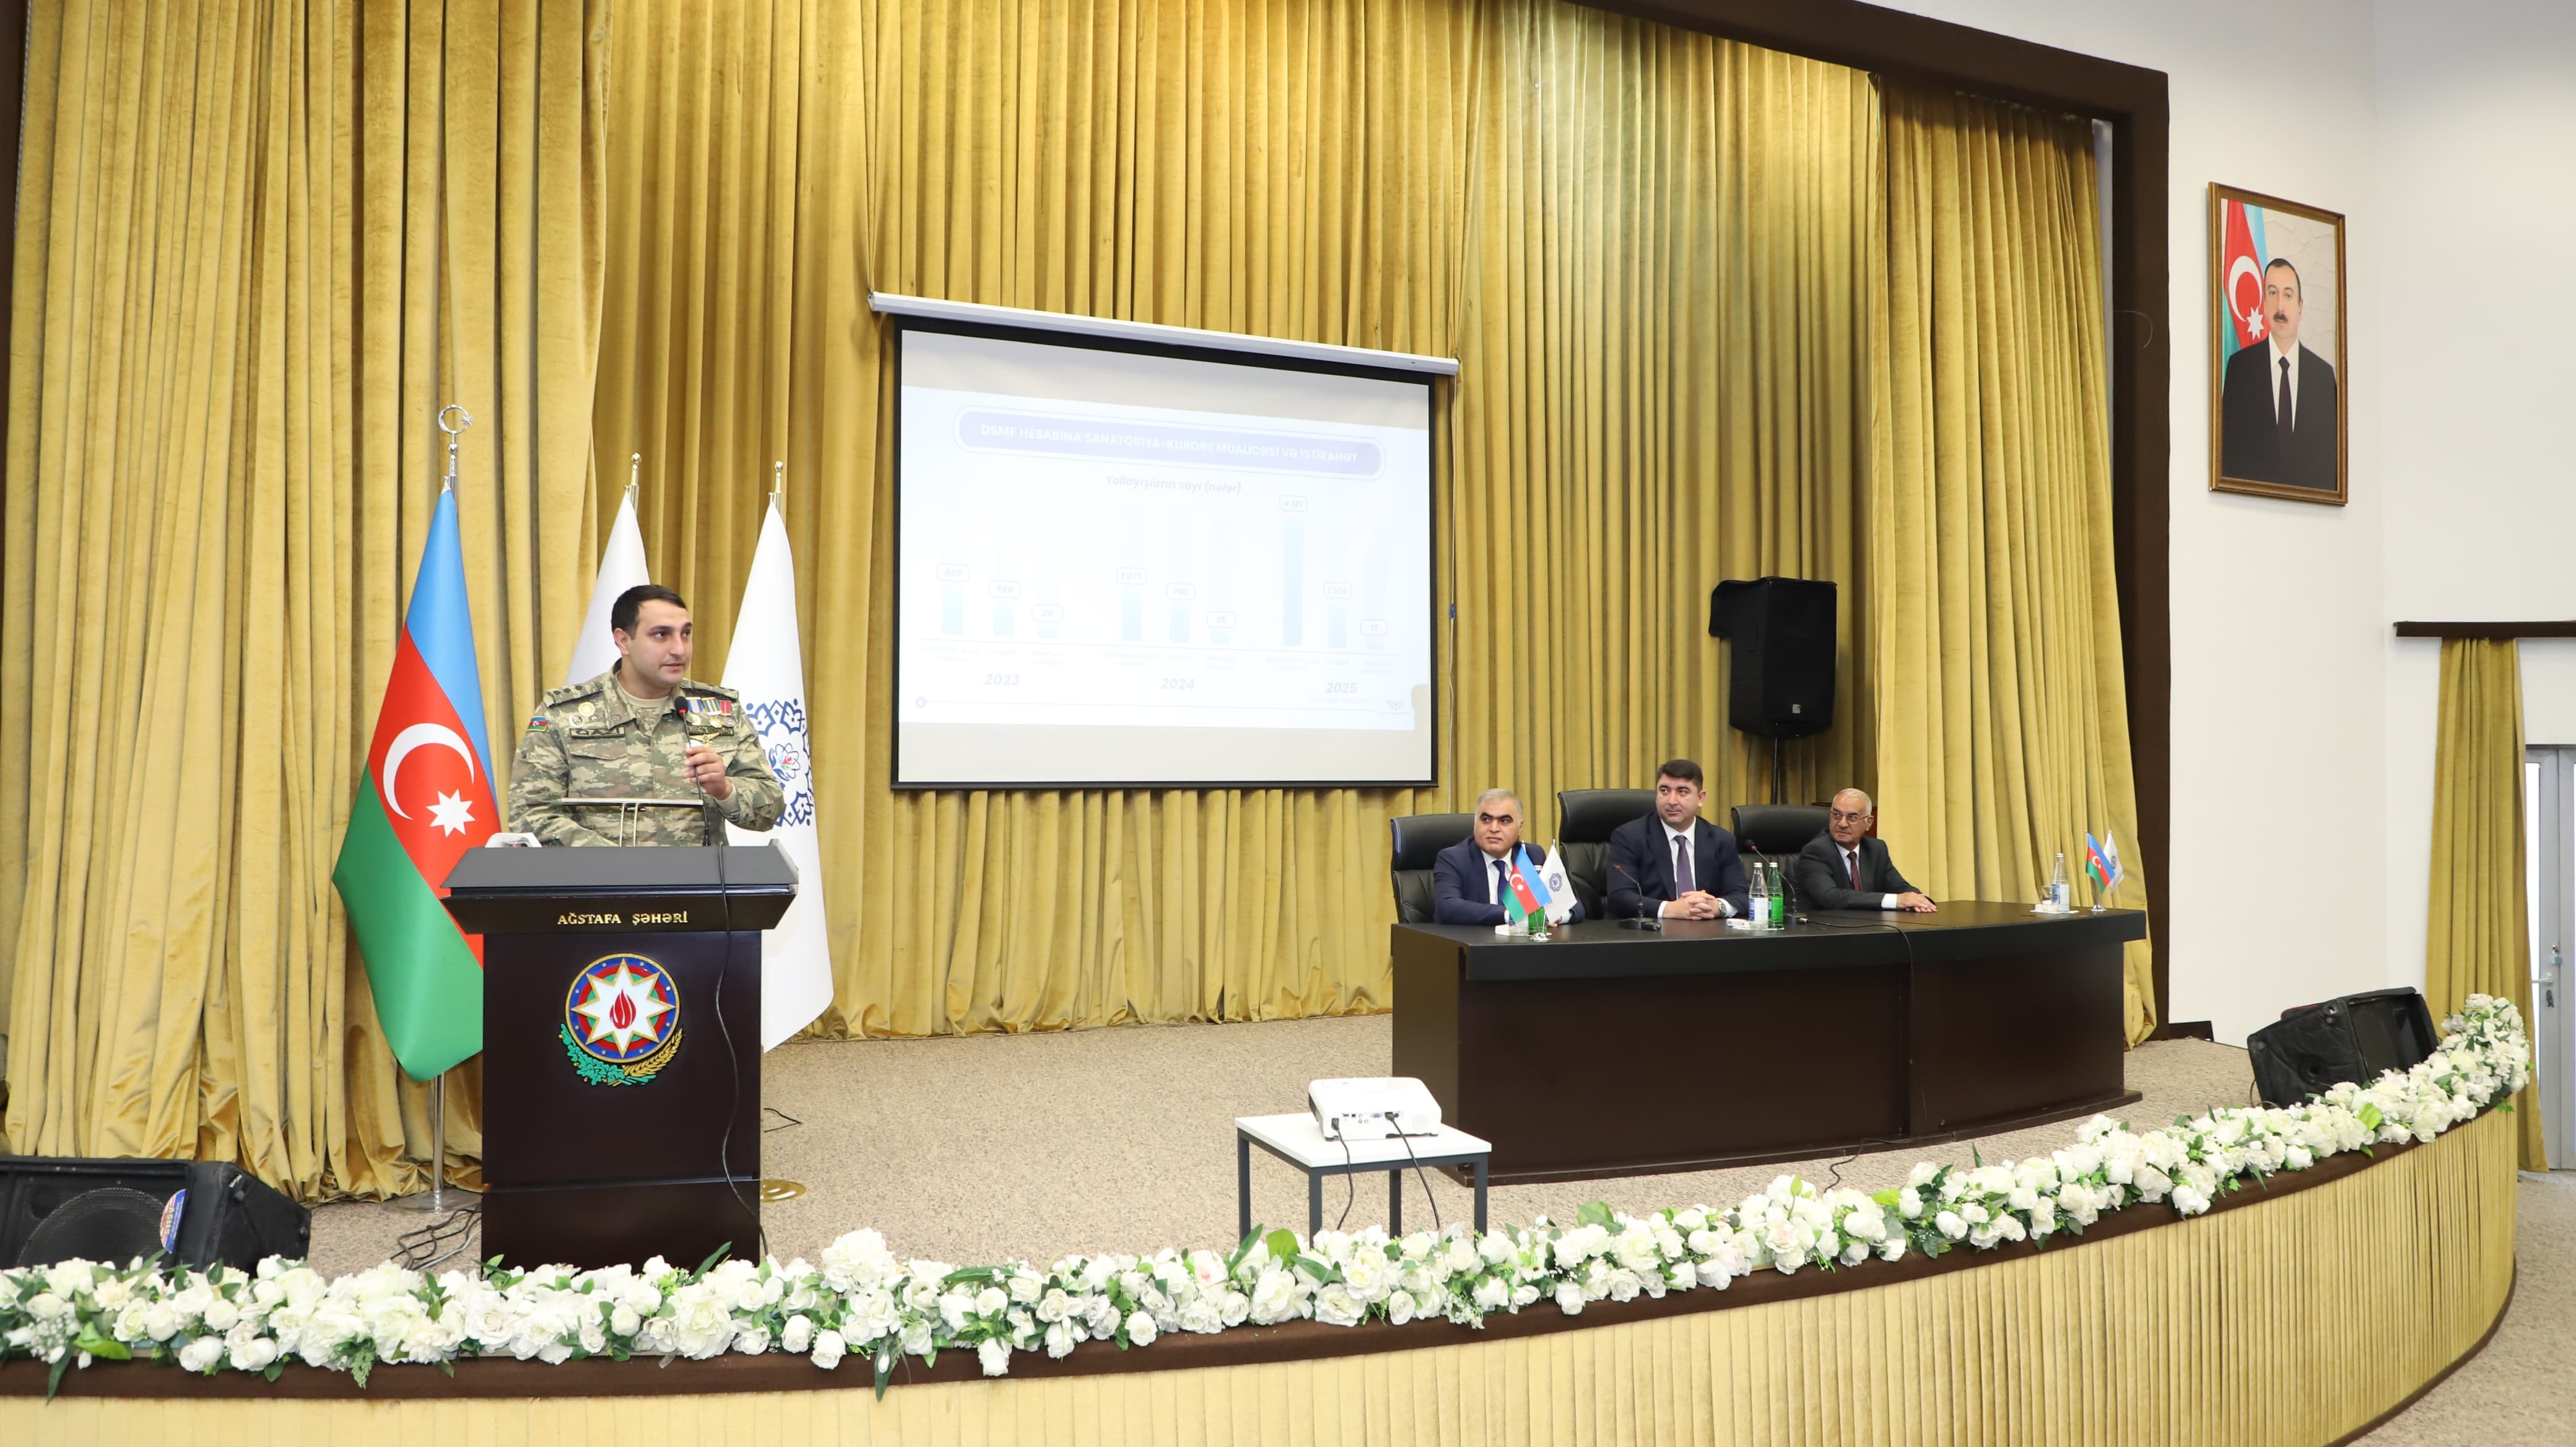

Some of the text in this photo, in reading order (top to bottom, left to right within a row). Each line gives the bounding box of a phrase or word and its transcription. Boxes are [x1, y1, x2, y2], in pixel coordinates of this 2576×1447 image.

[981, 424, 1016, 437] DSMF
[1020, 427, 1082, 442] HESABINA
[984, 673, 1021, 686] 2023
[1160, 678, 1195, 690] 2024
[1326, 682, 1358, 694] 2025
[557, 911, 689, 926] AĞSTAFA ŞƏHƏRİ
